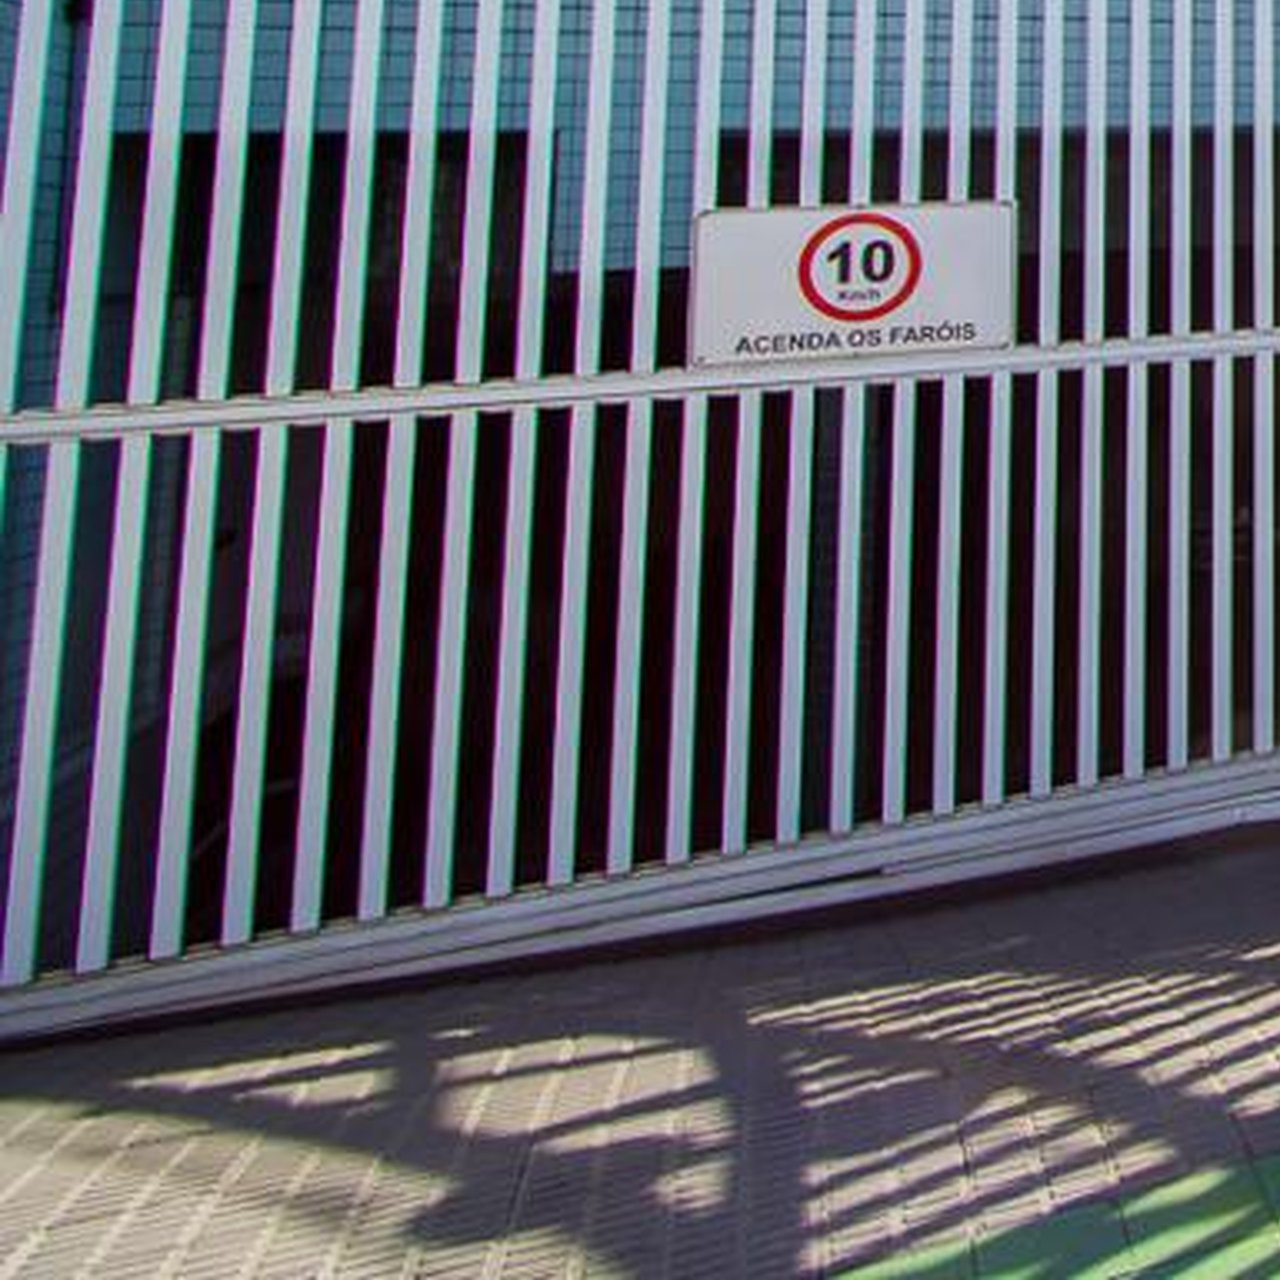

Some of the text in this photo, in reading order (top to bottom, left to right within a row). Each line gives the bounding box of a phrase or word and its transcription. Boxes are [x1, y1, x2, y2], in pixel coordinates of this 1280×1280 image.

[826, 239, 896, 285] 10
[735, 321, 977, 355] ACENDA OS FARÓIS
